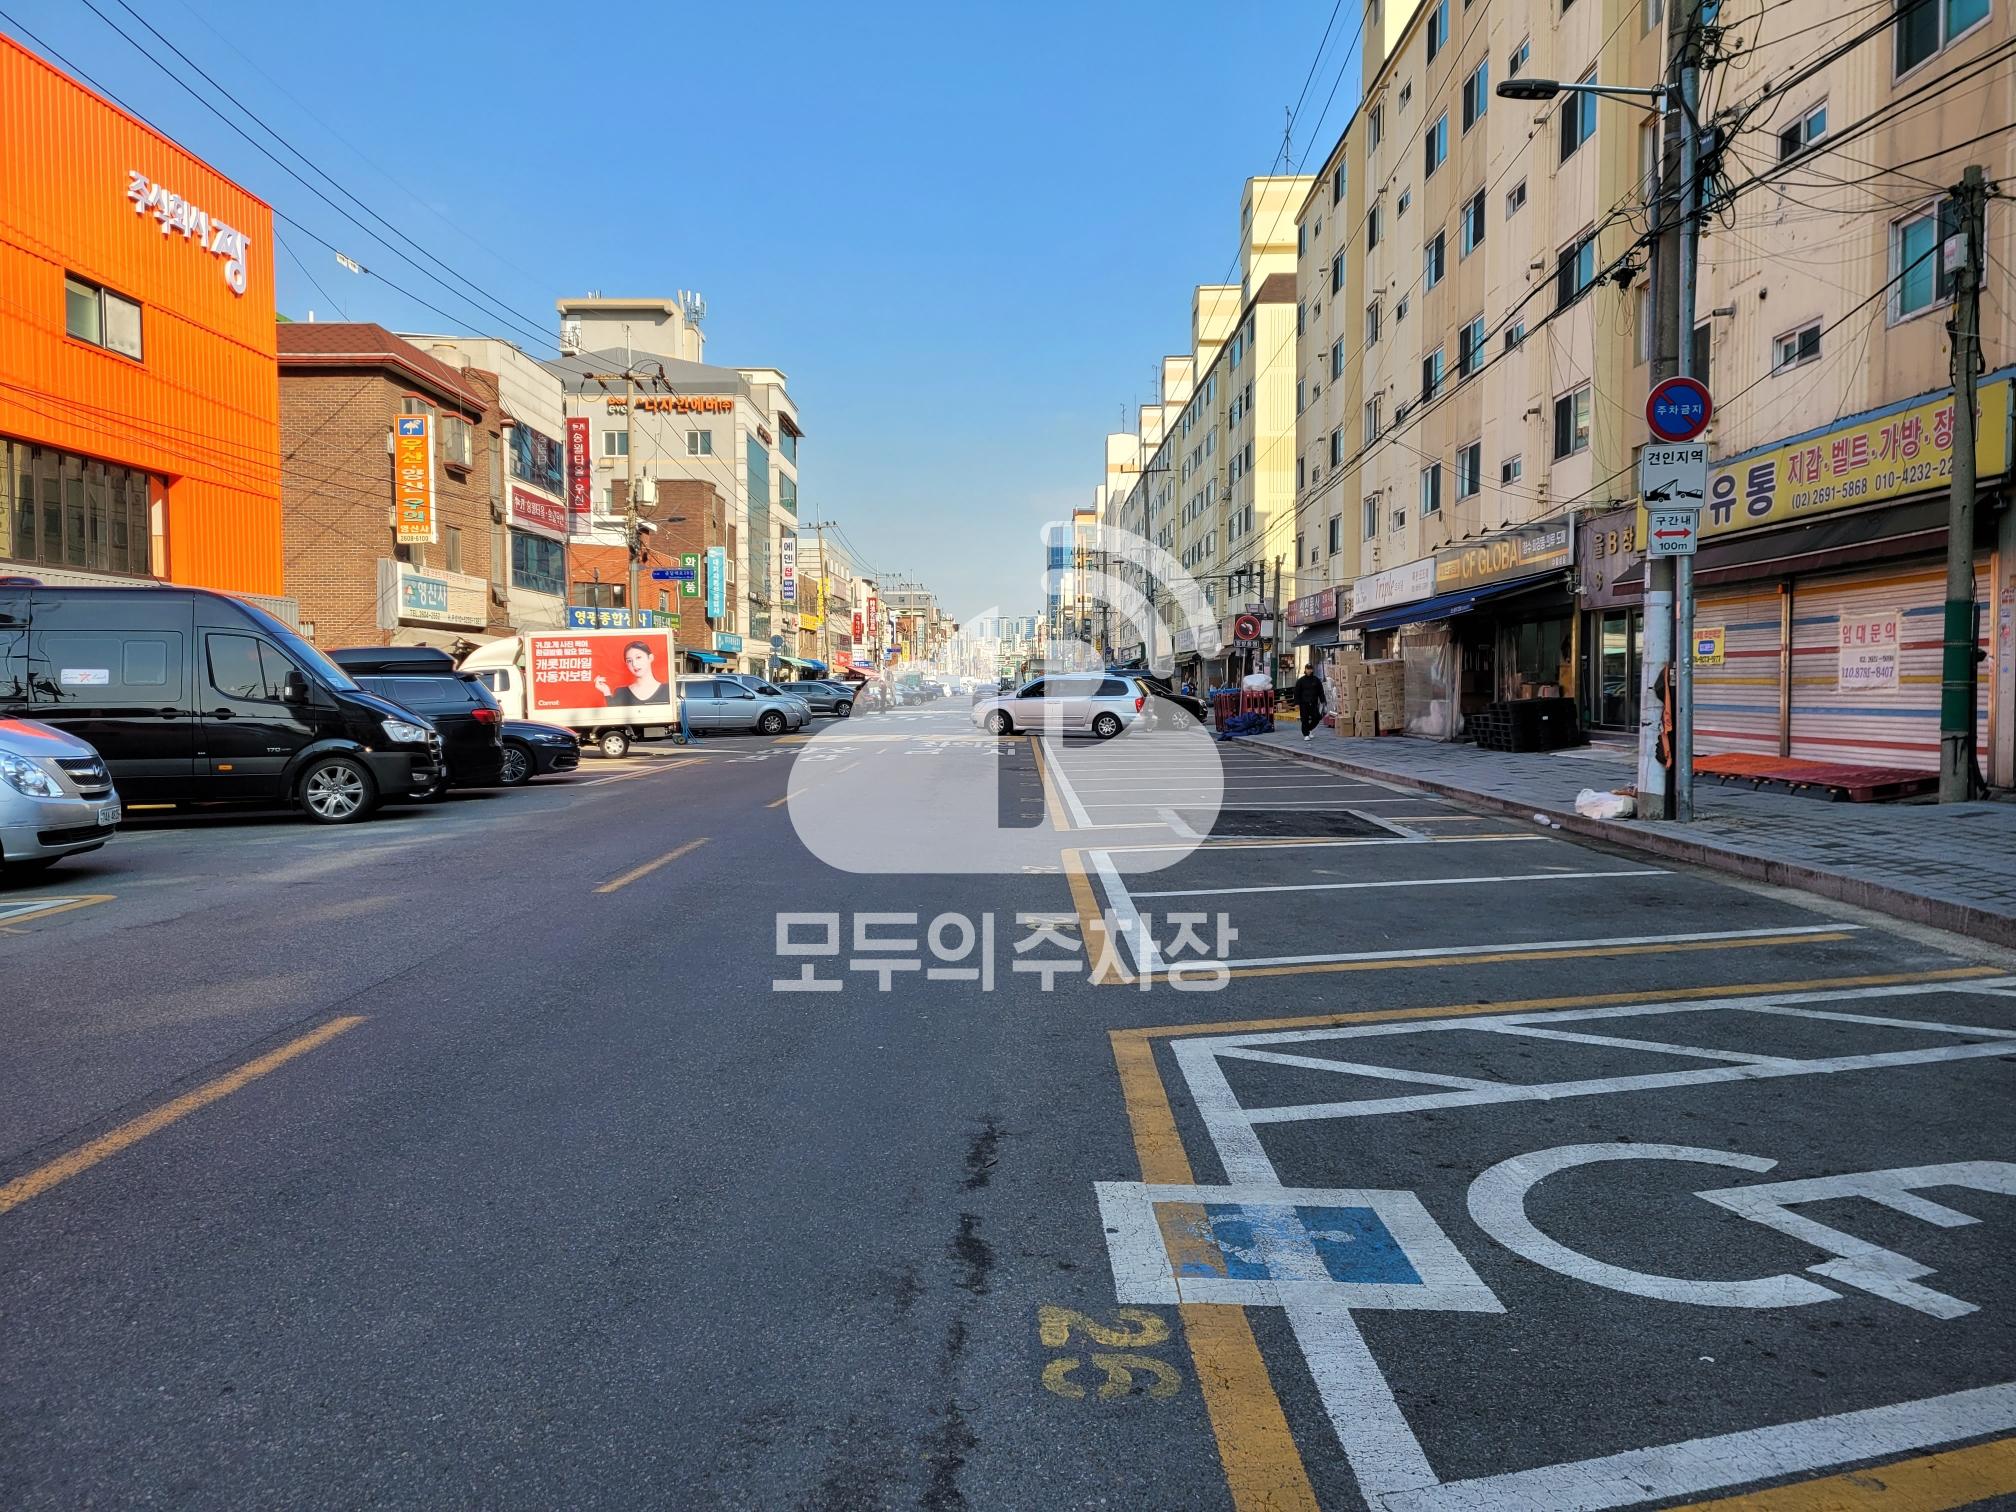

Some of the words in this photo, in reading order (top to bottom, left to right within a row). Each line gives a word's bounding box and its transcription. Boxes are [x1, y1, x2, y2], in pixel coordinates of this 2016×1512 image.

[128, 170, 208, 248] 주식회사
[608, 404, 628, 414] eve
[645, 396, 735, 414] 디자인에버(주)
[1657, 404, 1702, 416] 주차금지
[1648, 450, 1703, 466] 견인지역
[1709, 461, 1777, 526] 유통
[1656, 515, 1691, 526] 구간내
[783, 542, 793, 565] 에덴
[1659, 542, 1688, 551] 100m
[1462, 550, 1477, 578] CF
[1375, 573, 1394, 604] Triple
[1842, 622, 1897, 644] 임대문의
[535, 670, 592, 683] 자동차보험
